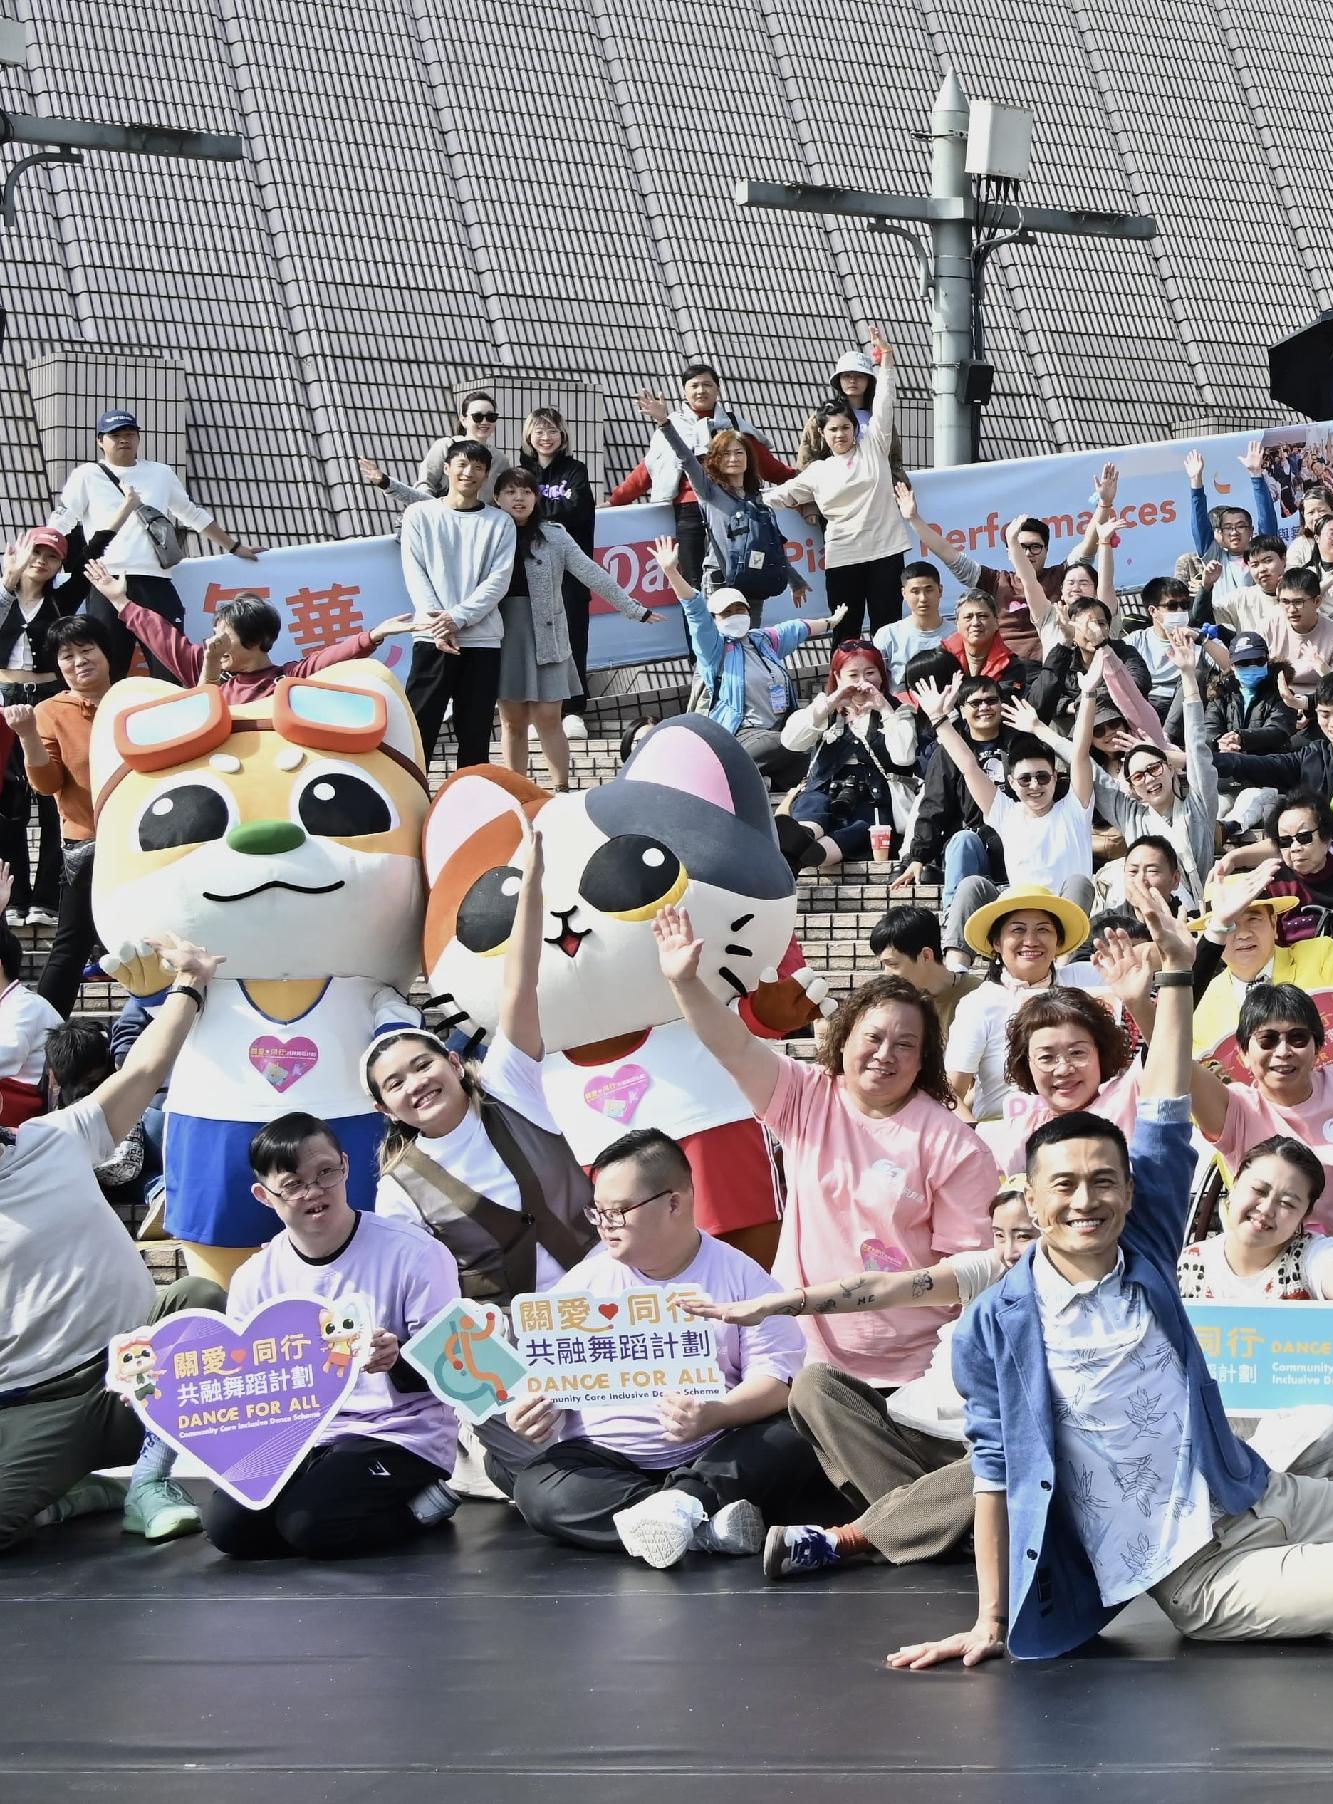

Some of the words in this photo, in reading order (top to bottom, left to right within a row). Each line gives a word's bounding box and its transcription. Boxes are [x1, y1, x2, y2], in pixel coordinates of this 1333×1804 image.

[919, 499, 1177, 557] Perfmaces
[603, 545, 673, 595] Da
[519, 1296, 598, 1334] 關愛
[173, 1345, 230, 1380] 關愛
[252, 1332, 312, 1367] 同行
[525, 1329, 711, 1367] 共融舞蹈計劃
[1195, 1326, 1265, 1359] 同行
[1271, 1341, 1331, 1356] DANCE
[527, 1373, 610, 1393] DANCE
[619, 1369, 668, 1388] FOR
[678, 1366, 720, 1385] ALL
[1272, 1361, 1333, 1375] Community
[1272, 1375, 1320, 1386] Inclusive
[176, 1364, 314, 1408] 共融舞蹈計劃
[551, 1394, 581, 1404] munity
[584, 1393, 607, 1402] Care
[609, 1391, 650, 1400] Inclusive
[652, 1389, 681, 1398] Dae
[683, 1387, 720, 1396] Scheme
[178, 1406, 240, 1429] DANCE
[245, 1402, 281, 1419] FOR
[288, 1393, 321, 1412] ALL
[178, 1426, 219, 1439] Community
[219, 1423, 238, 1433] Care
[237, 1419, 269, 1431] Inclusive
[269, 1416, 292, 1427] Dance
[292, 1410, 322, 1422] Scheme
